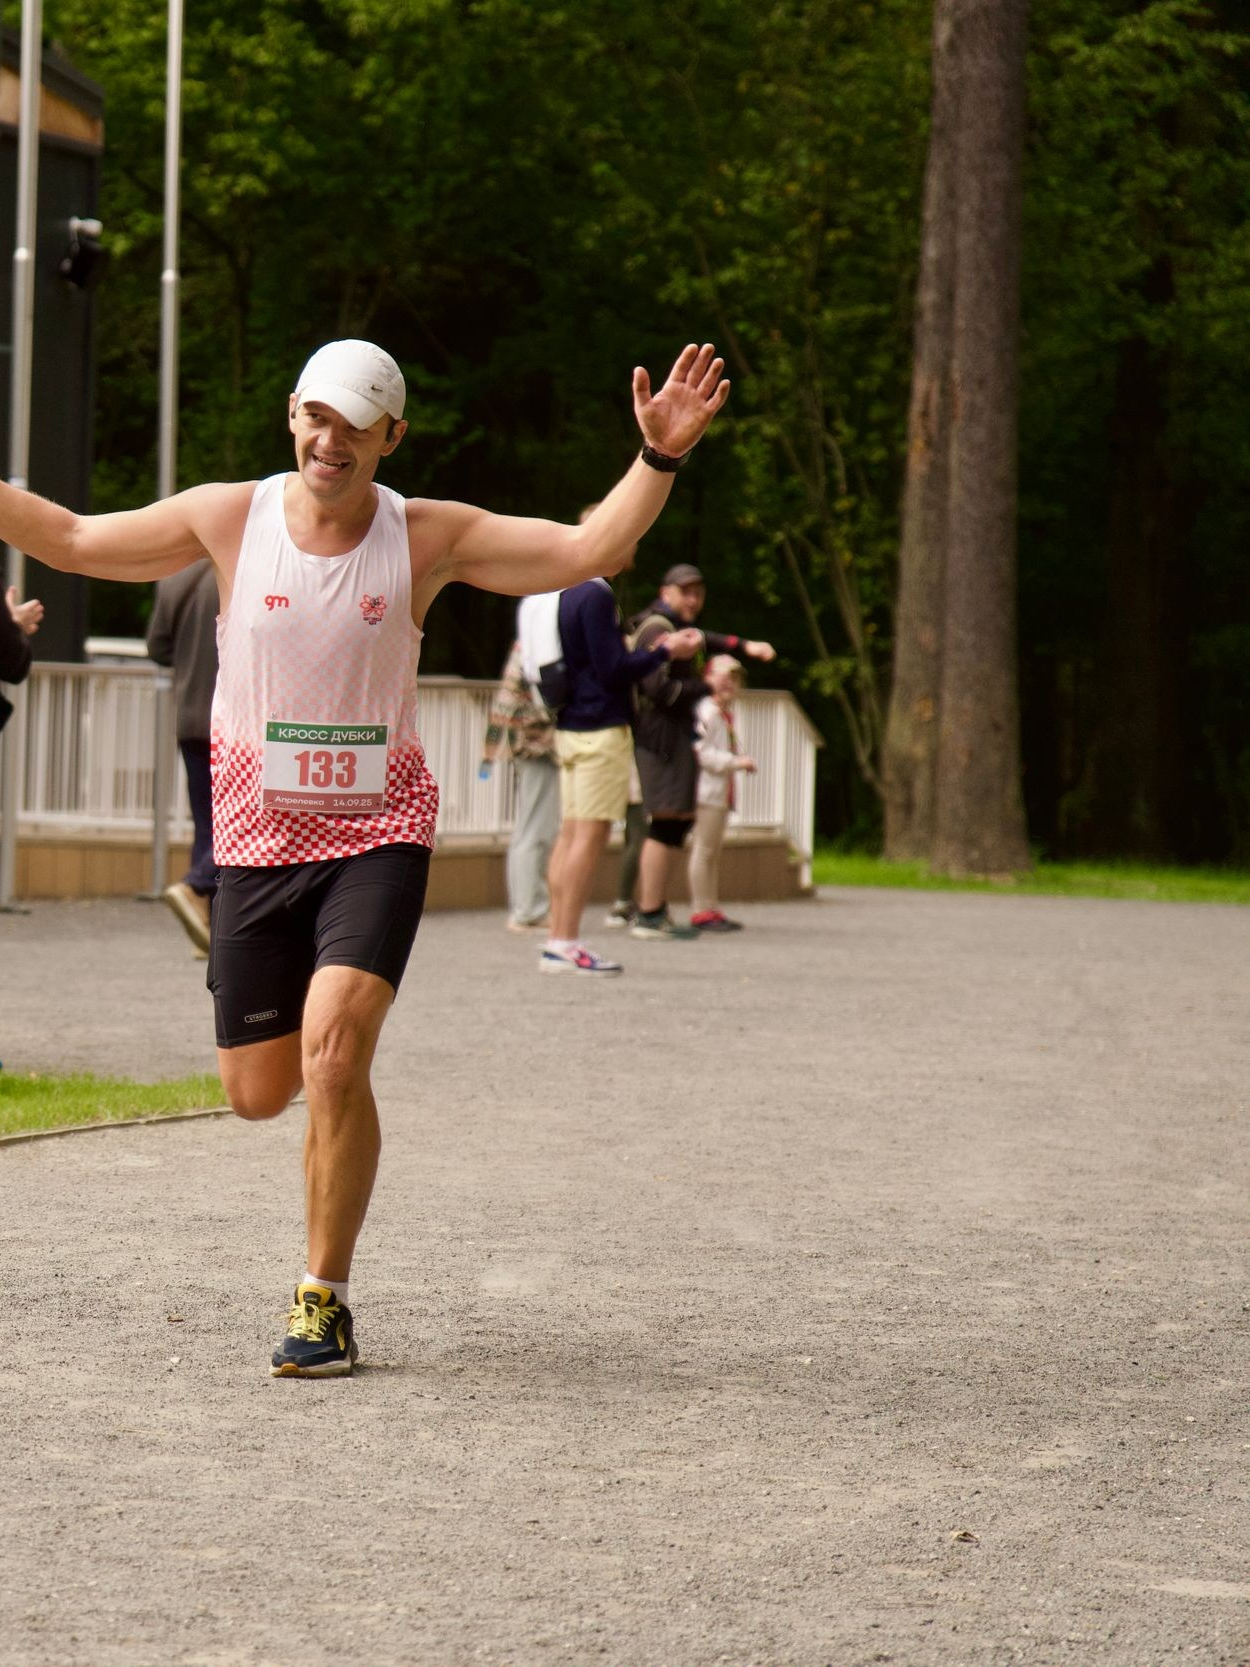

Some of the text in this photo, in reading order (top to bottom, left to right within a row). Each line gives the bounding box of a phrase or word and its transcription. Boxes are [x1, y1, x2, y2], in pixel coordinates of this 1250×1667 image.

[278, 727, 377, 743] КРОСС ДУБКИ
[294, 750, 357, 789] 133
[274, 795, 373, 807] Апрелевка 14.09.25
